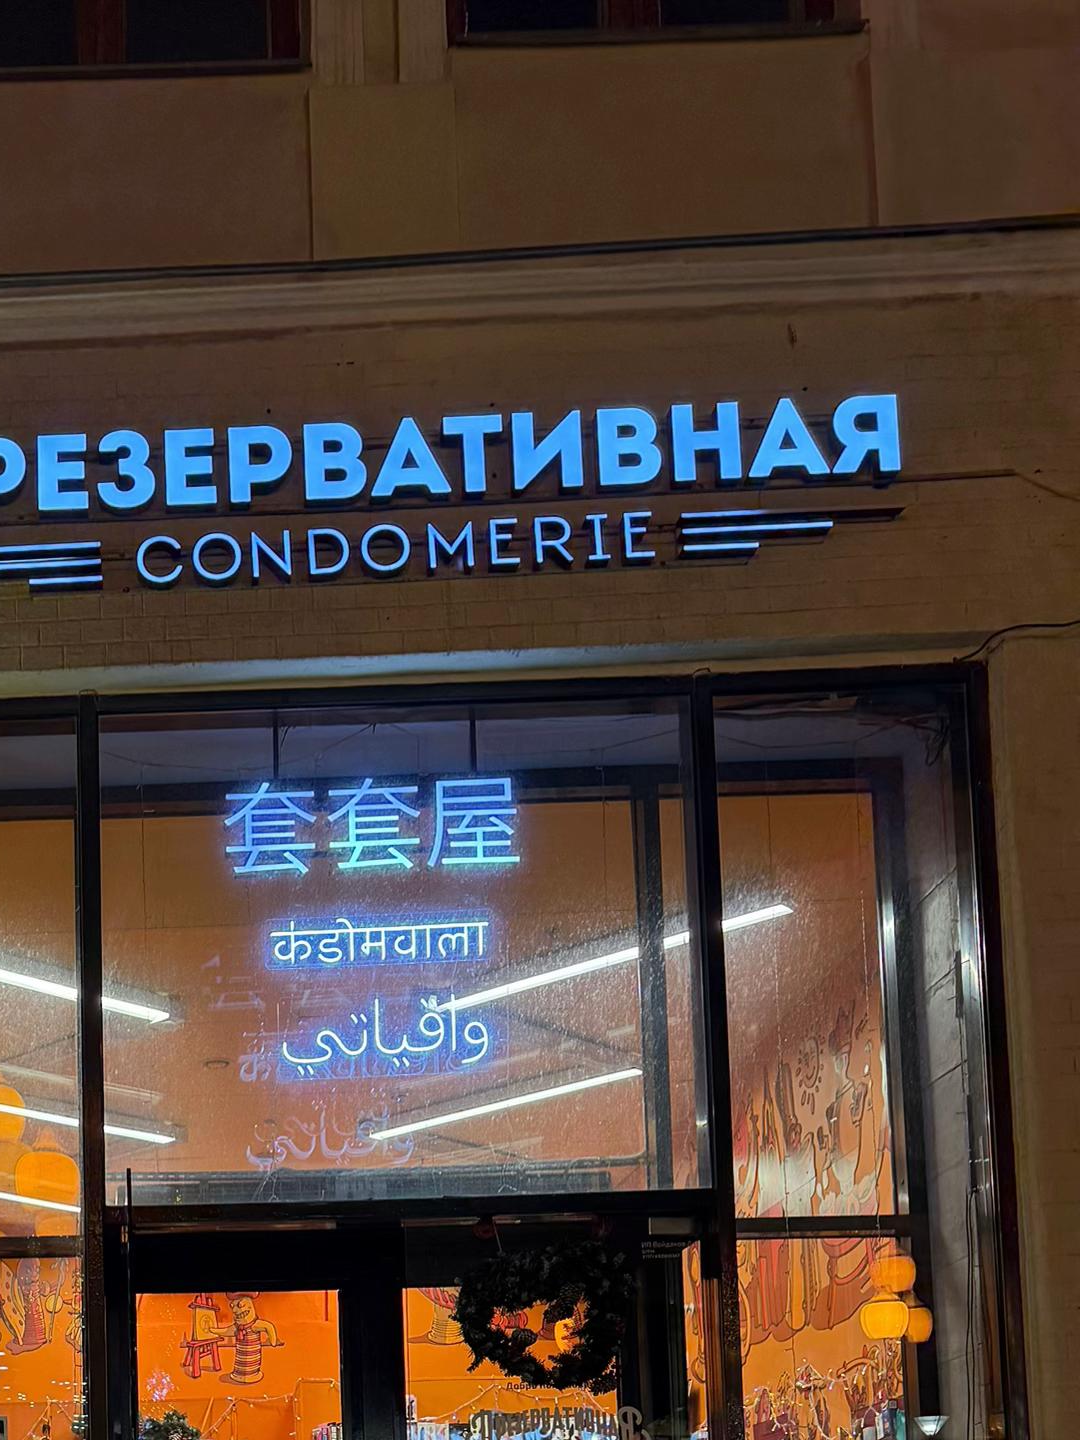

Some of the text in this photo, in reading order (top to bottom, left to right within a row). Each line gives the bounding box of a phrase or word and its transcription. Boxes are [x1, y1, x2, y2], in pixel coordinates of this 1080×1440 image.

[136, 511, 656, 585] CONDOMERIE
[224, 777, 521, 876] 套套屋
[269, 917, 490, 966] कंडोमवाला
